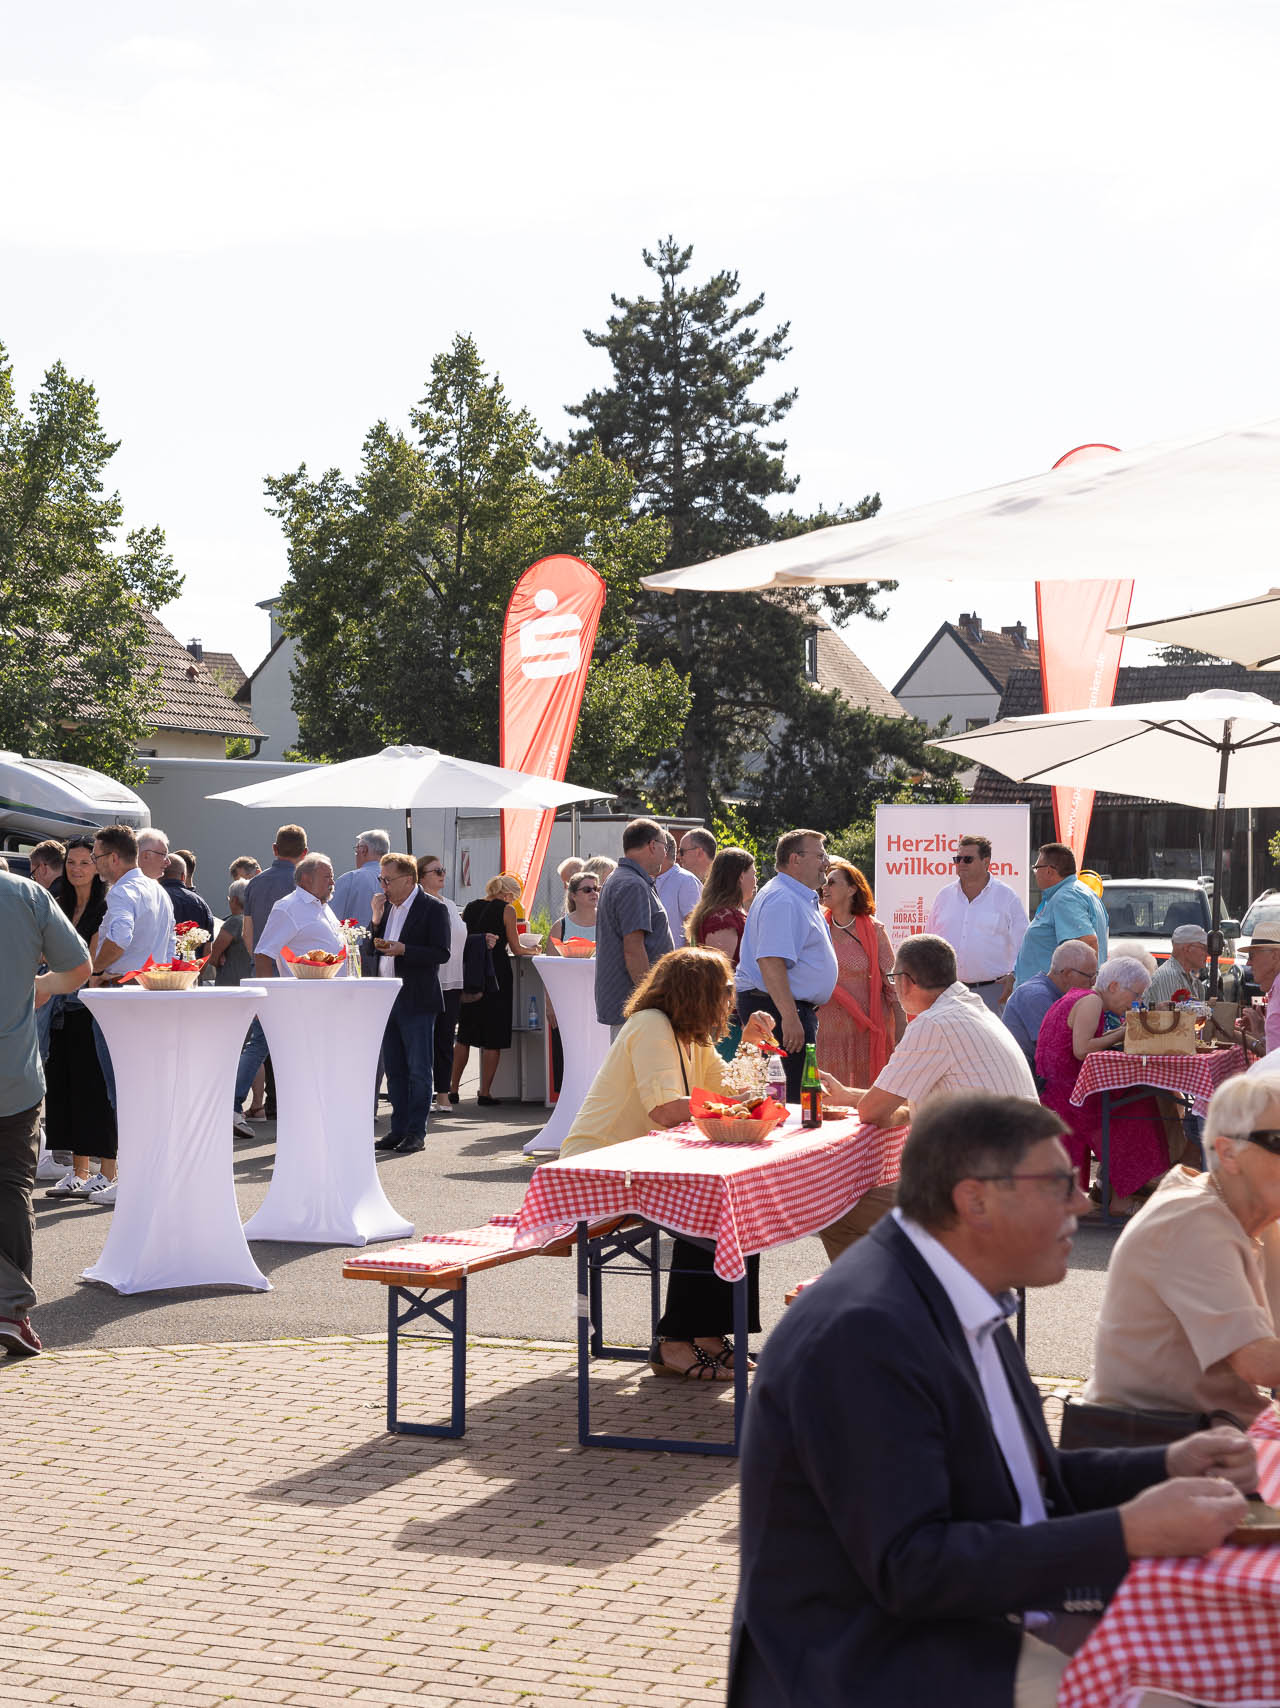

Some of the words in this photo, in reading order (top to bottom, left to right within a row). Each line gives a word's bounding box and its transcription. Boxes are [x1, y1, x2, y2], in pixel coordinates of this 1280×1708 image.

[886, 833, 964, 852] Herzlic
[885, 857, 1019, 876] willkoen.
[893, 912, 917, 923] HORAS
